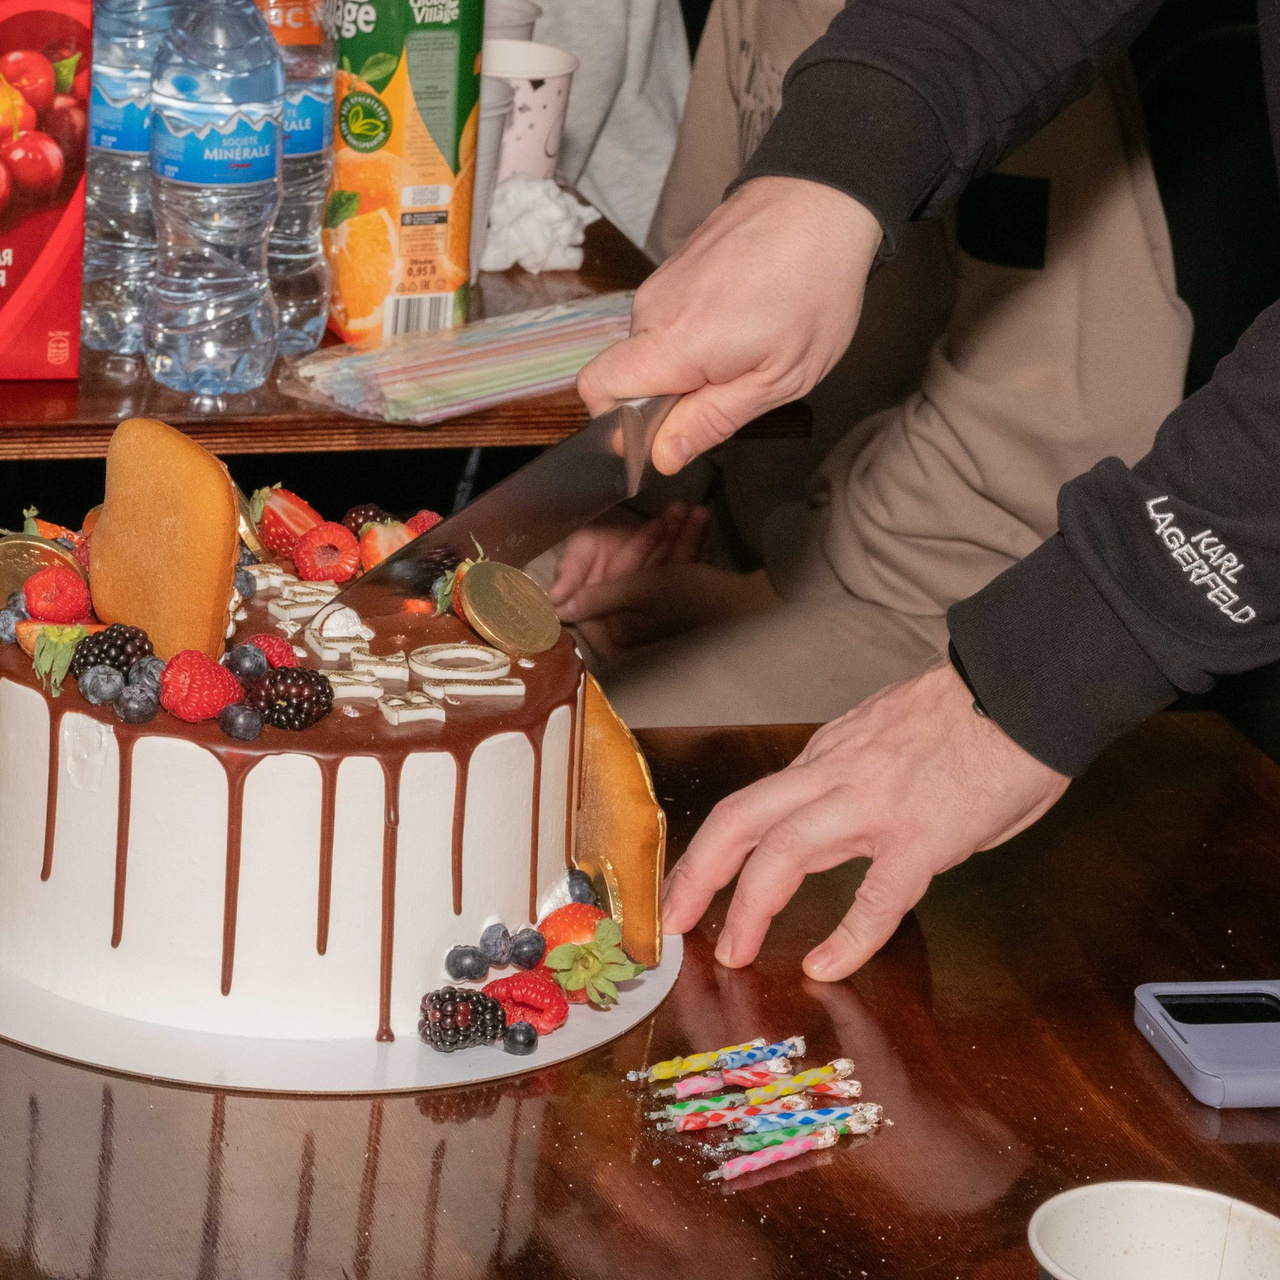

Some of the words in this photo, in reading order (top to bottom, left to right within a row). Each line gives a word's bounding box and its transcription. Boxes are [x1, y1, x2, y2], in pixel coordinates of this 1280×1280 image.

[412, 5, 459, 24] Village
[203, 144, 270, 161] MINÉRALE
[1145, 495, 1257, 623] LAGERFELD
[1190, 529, 1245, 584] KARL
